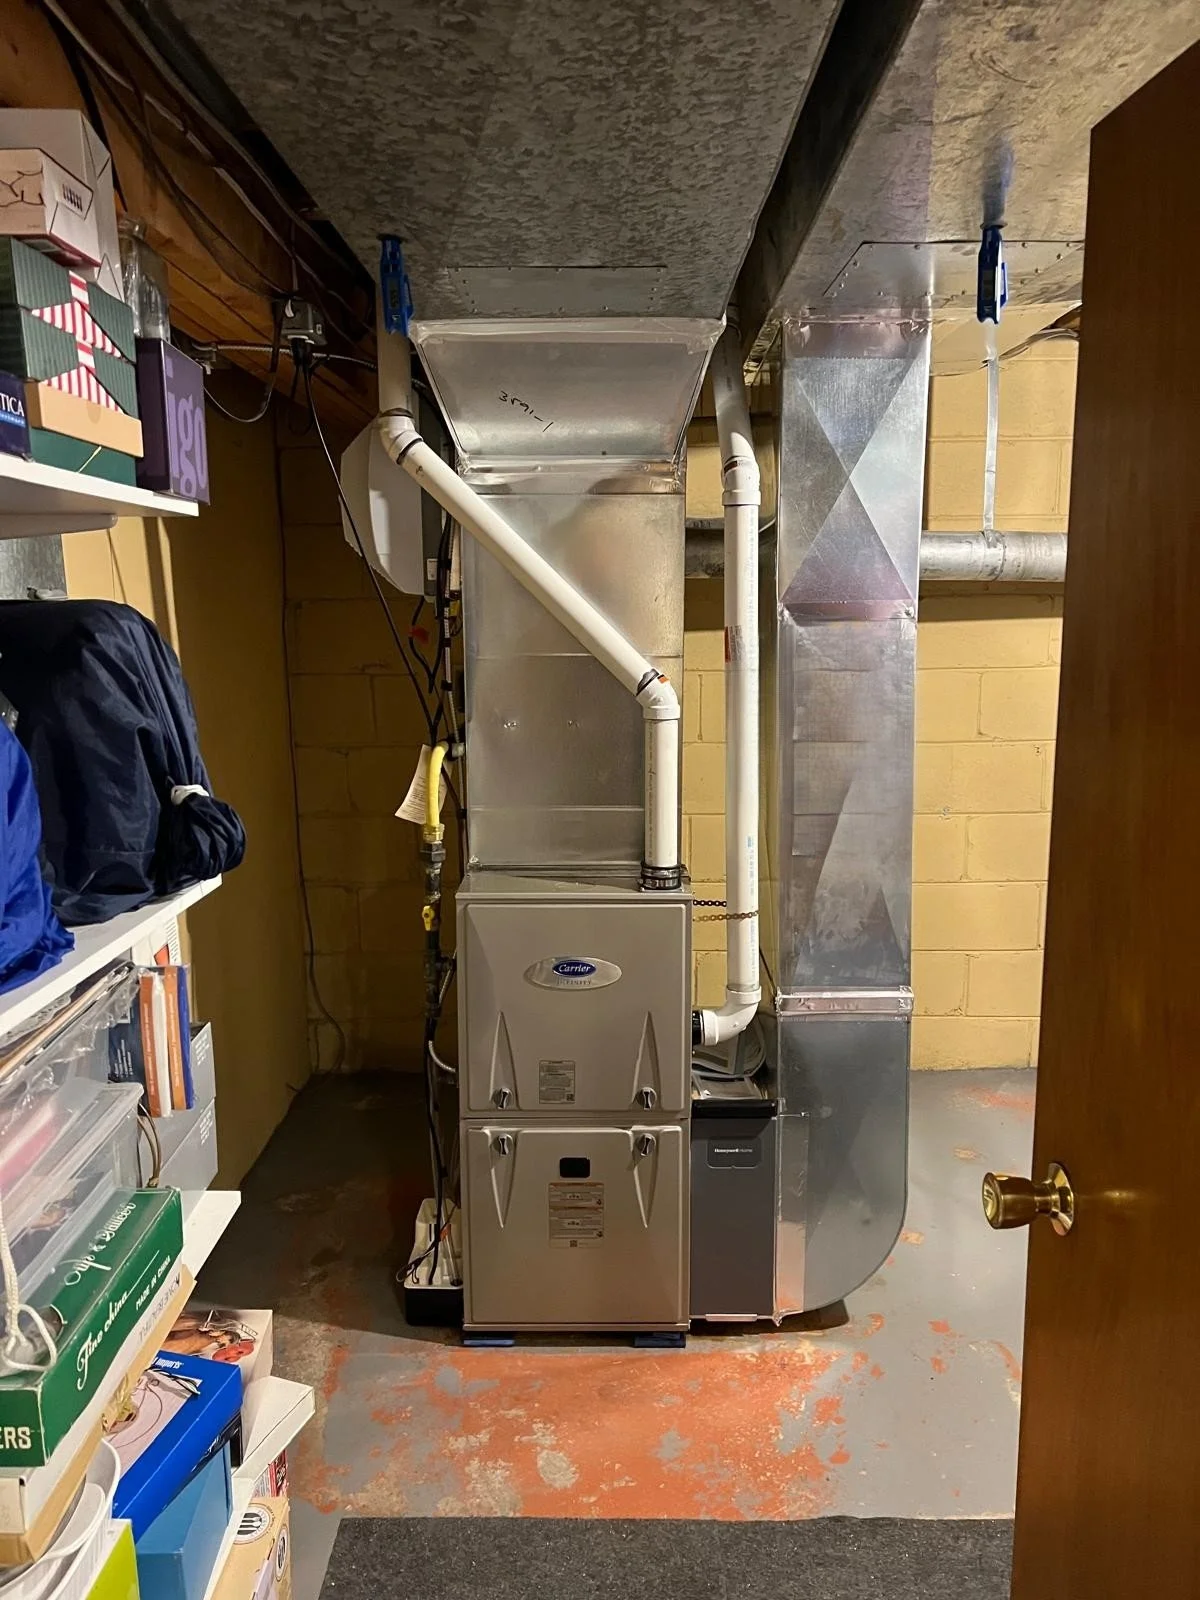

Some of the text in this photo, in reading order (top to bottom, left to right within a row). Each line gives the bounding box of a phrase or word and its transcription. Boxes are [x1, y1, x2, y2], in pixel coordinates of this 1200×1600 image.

[558, 963, 591, 973] Carrier
[77, 1290, 129, 1391] Fine china
